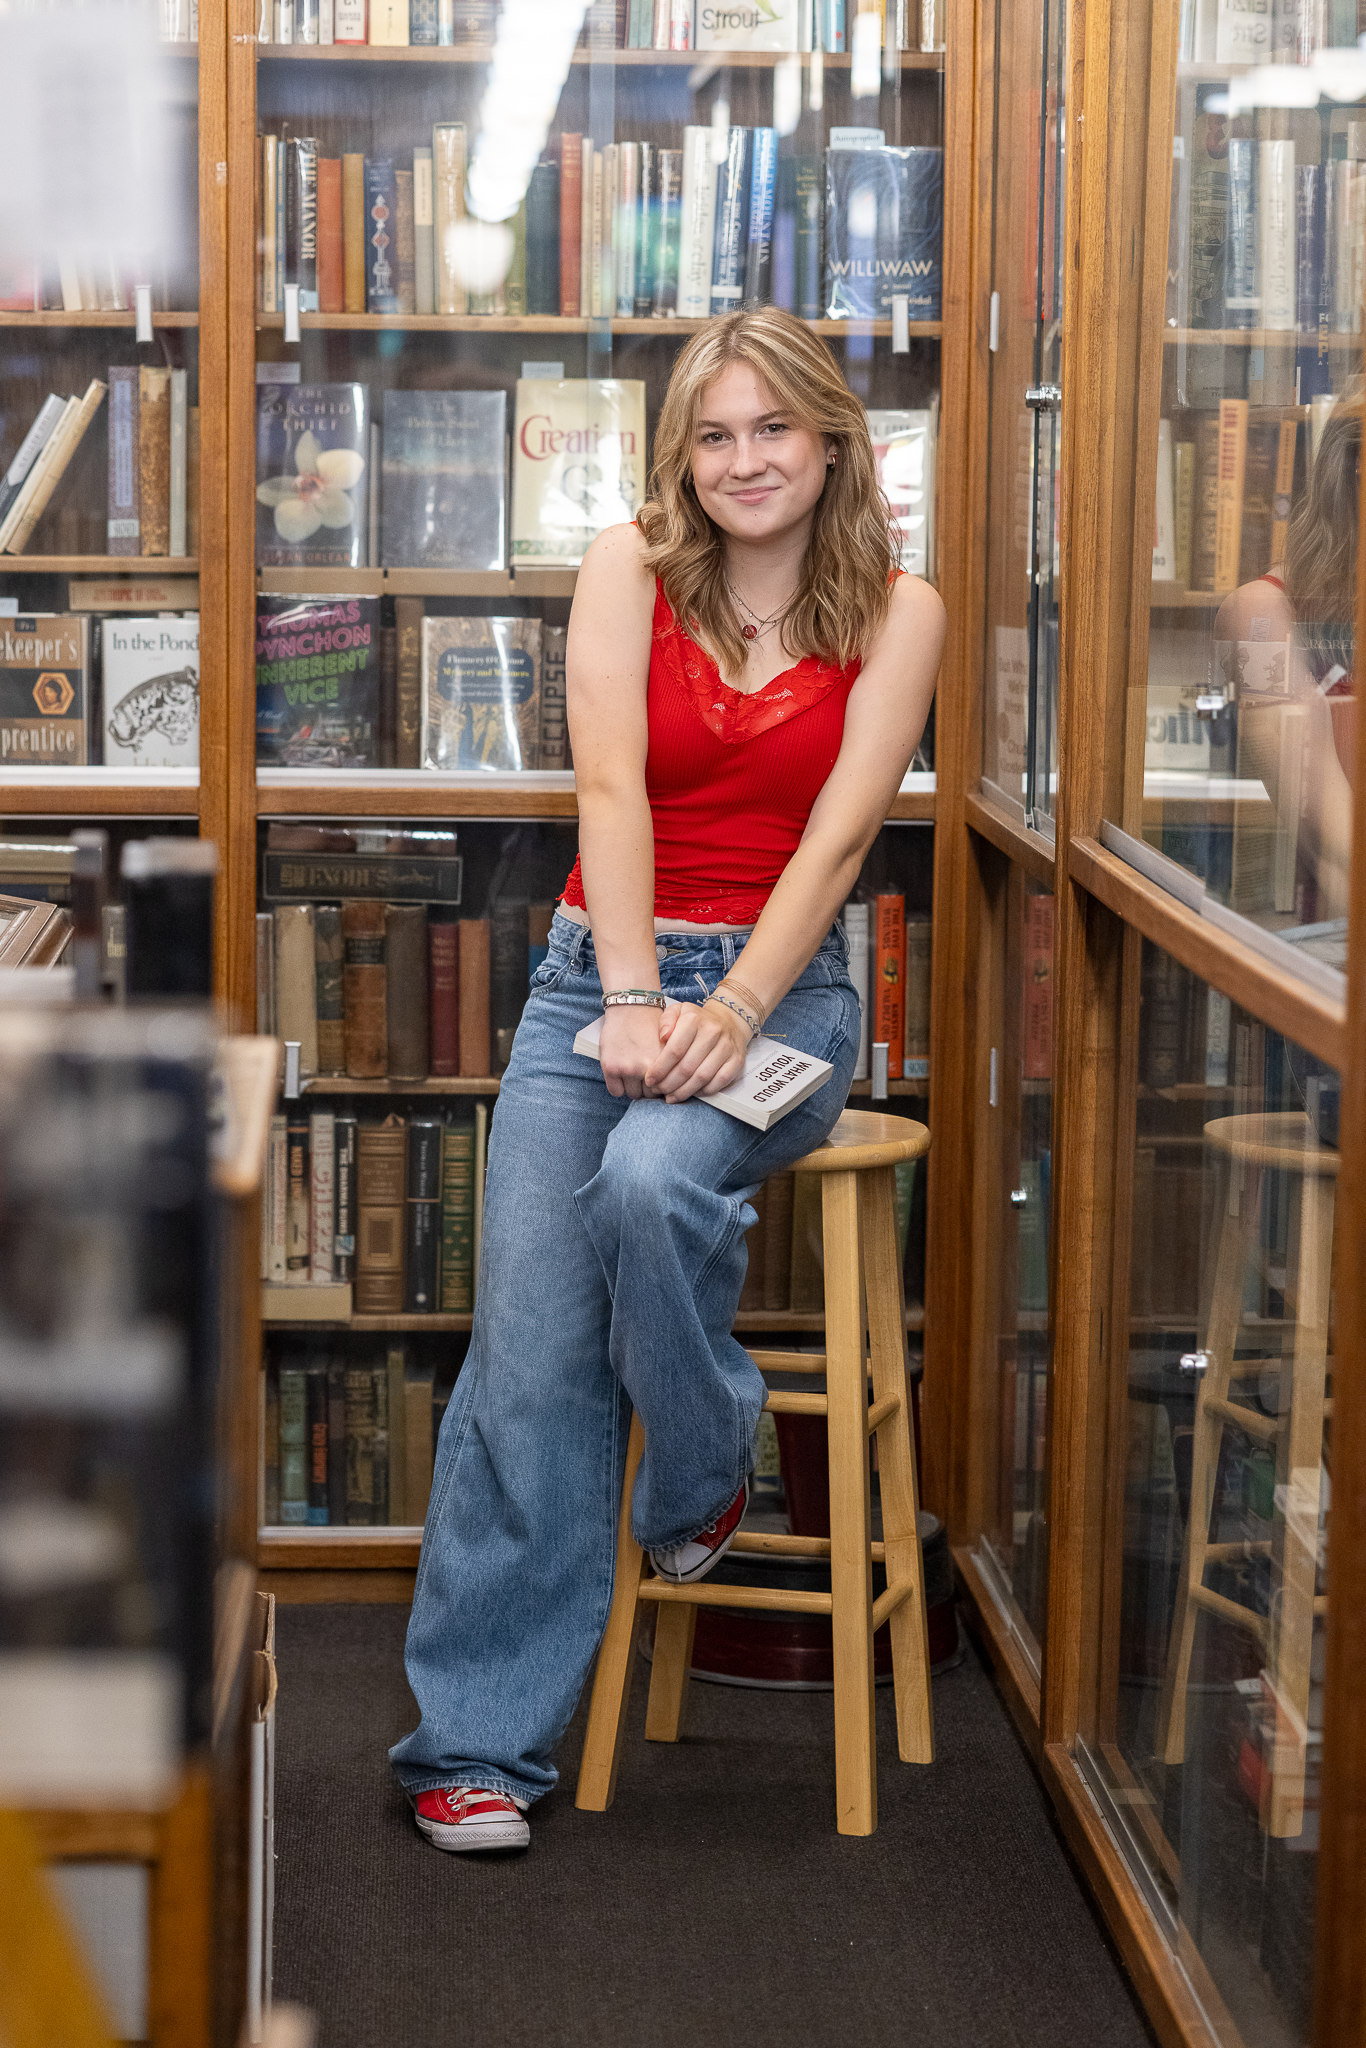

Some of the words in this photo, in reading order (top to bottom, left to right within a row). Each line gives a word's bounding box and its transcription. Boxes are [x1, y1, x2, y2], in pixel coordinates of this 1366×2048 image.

[702, 8, 760, 30] Strout
[829, 259, 933, 277] WILLIWAW
[268, 401, 352, 416] ORCHID
[520, 414, 637, 461] Creatin
[258, 600, 361, 637] THOMAS
[113, 632, 127, 650] In
[131, 632, 156, 651] the
[255, 623, 371, 661] PYNCHON
[283, 677, 340, 707] VICE
[543, 651, 567, 758] ECLIPSE
[771, 1054, 796, 1070] YOU
[781, 1061, 813, 1081] WHAT
[755, 1066, 779, 1082] DO?
[753, 1079, 790, 1103] WOULD
